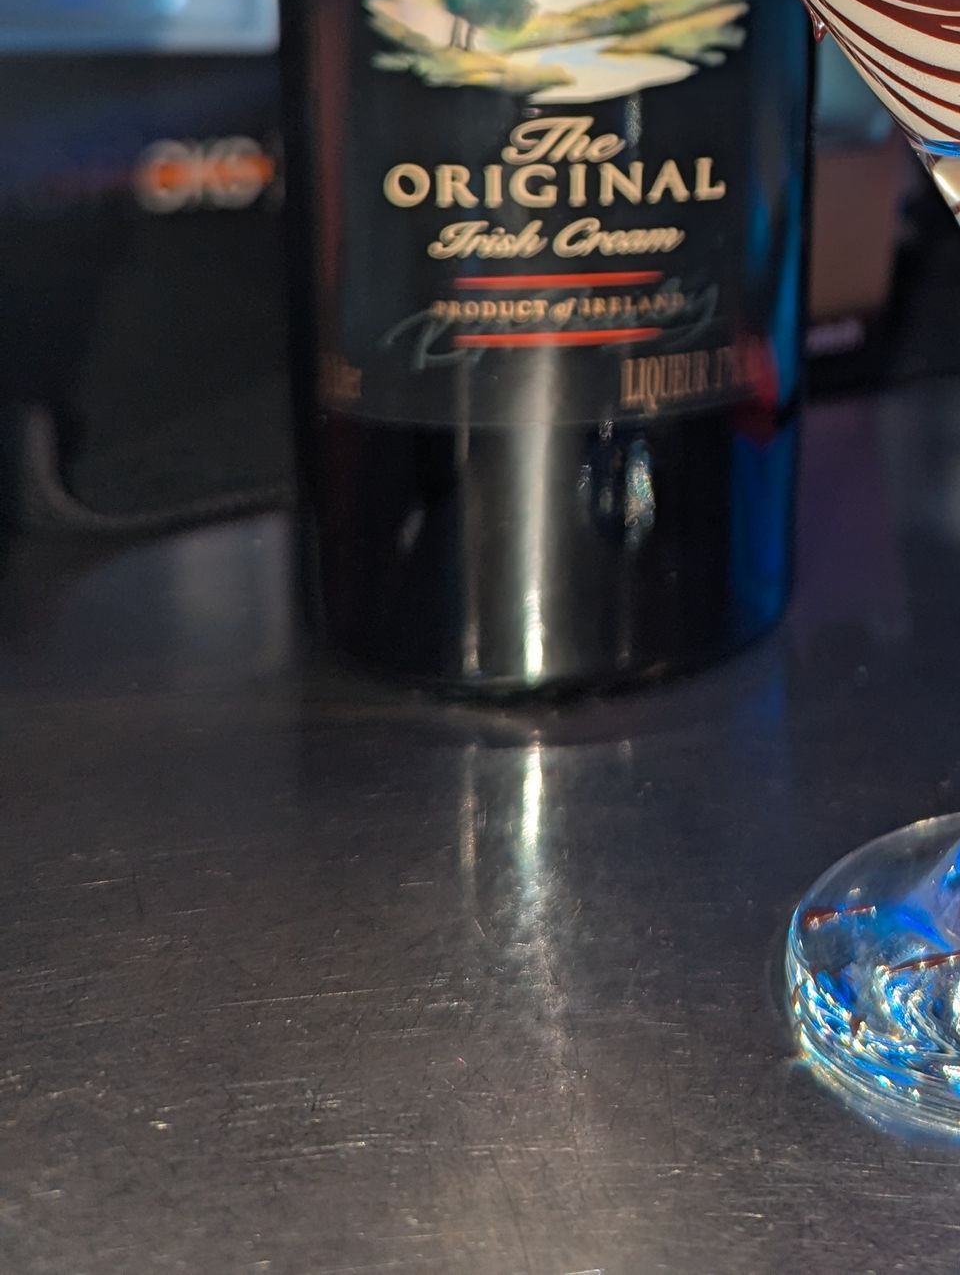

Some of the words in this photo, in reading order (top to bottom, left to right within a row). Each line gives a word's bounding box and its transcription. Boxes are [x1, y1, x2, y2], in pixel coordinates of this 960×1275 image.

[502, 116, 625, 164] The
[383, 157, 726, 208] ORIGINAL
[427, 219, 548, 259] Irish
[553, 217, 685, 257] Cream
[434, 299, 547, 324] PRODUCT
[550, 298, 576, 325] of
[578, 292, 686, 318] IRELAND
